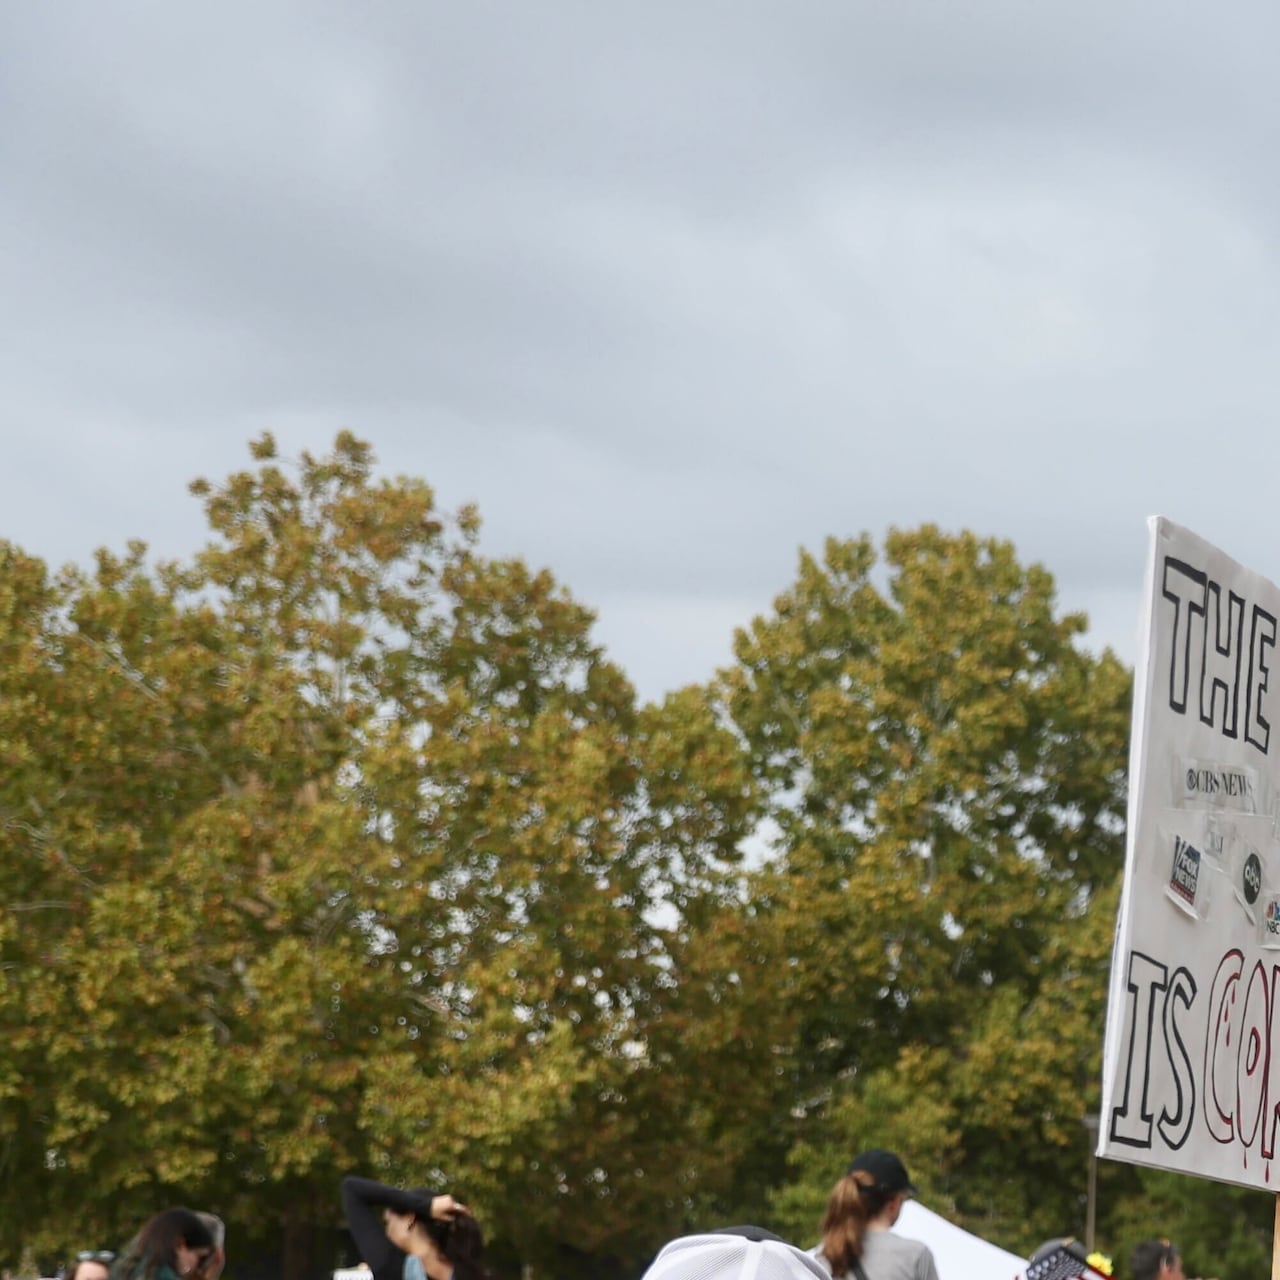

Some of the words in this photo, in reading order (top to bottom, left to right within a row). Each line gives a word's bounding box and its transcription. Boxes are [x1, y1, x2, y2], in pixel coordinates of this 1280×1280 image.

[1163, 556, 1277, 754] THE
[1197, 770, 1219, 793] CBS
[1181, 858, 1198, 877] FOX
[1245, 865, 1259, 893] abc
[1175, 868, 1196, 893] NEWS
[1266, 921, 1280, 935] NBC
[1110, 950, 1198, 1150] IS
